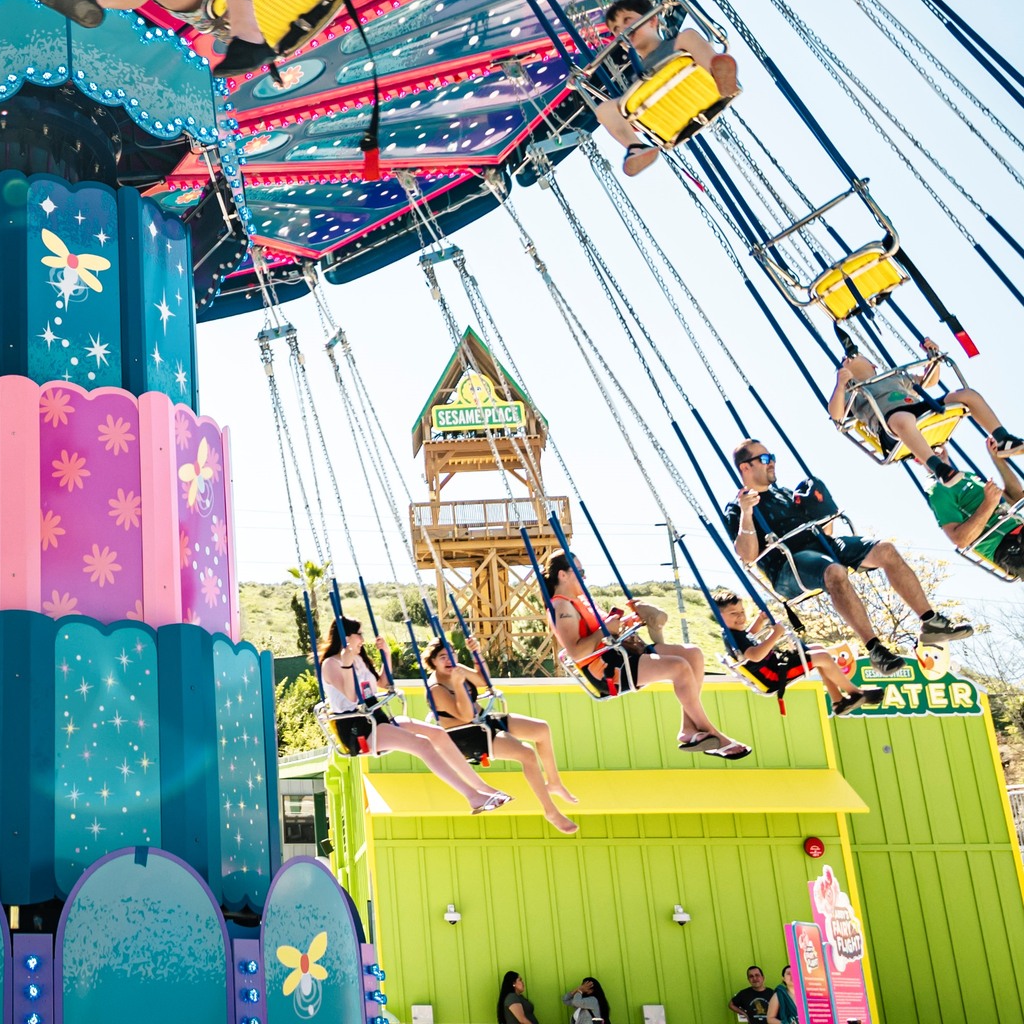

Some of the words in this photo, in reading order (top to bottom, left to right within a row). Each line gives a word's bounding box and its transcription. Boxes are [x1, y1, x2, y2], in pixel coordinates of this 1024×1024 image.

[437, 409, 481, 426] SESAME
[484, 407, 519, 424] PLACE
[837, 935, 861, 953] FLIGHT
